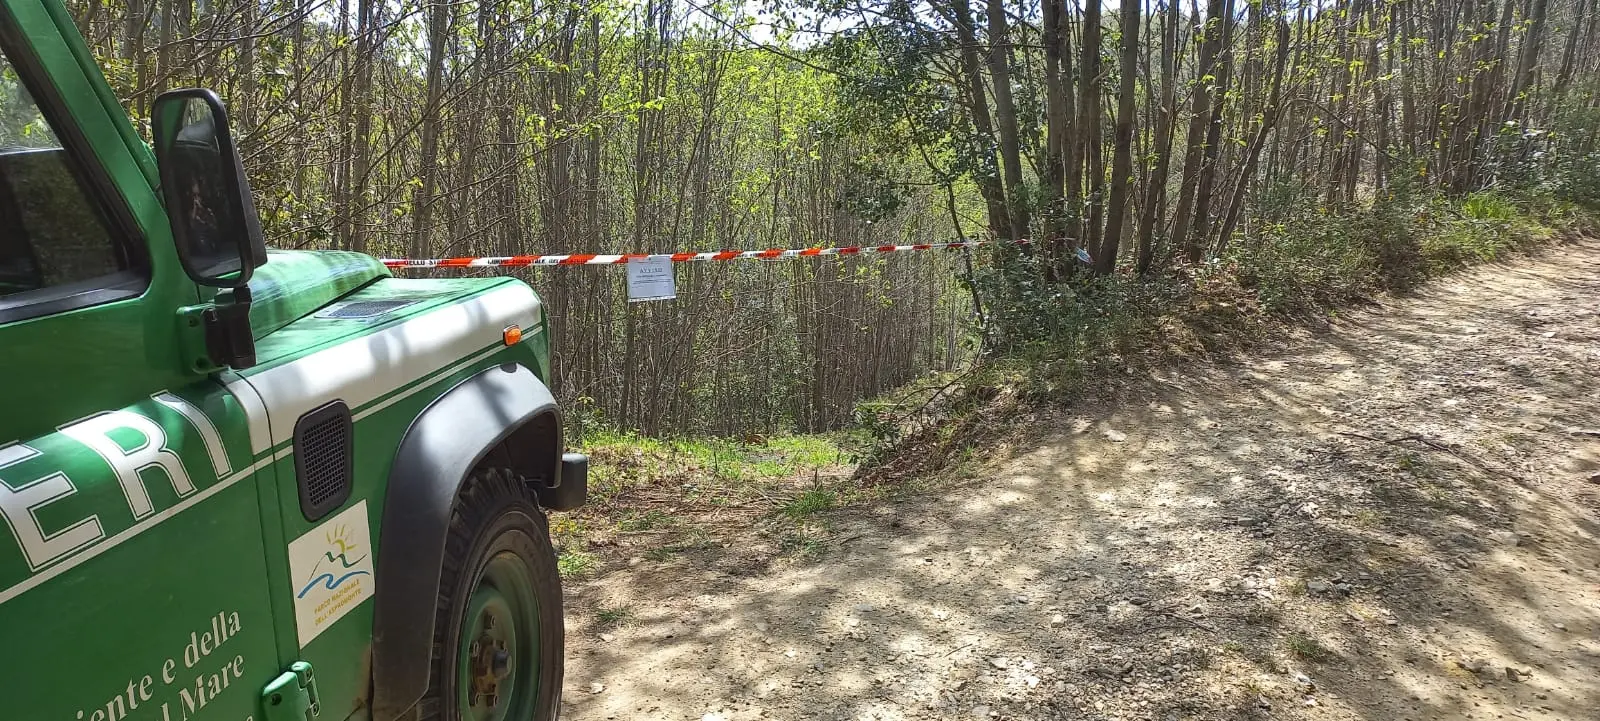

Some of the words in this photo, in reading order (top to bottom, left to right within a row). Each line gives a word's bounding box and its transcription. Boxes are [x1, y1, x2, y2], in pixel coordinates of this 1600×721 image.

[314, 598, 331, 614] PARCO
[332, 579, 360, 601] NAZIONALE
[314, 587, 361, 626] DELL'ASPROMONTE
[162, 658, 176, 685] e
[184, 610, 241, 668] della
[179, 654, 244, 721] Mare
